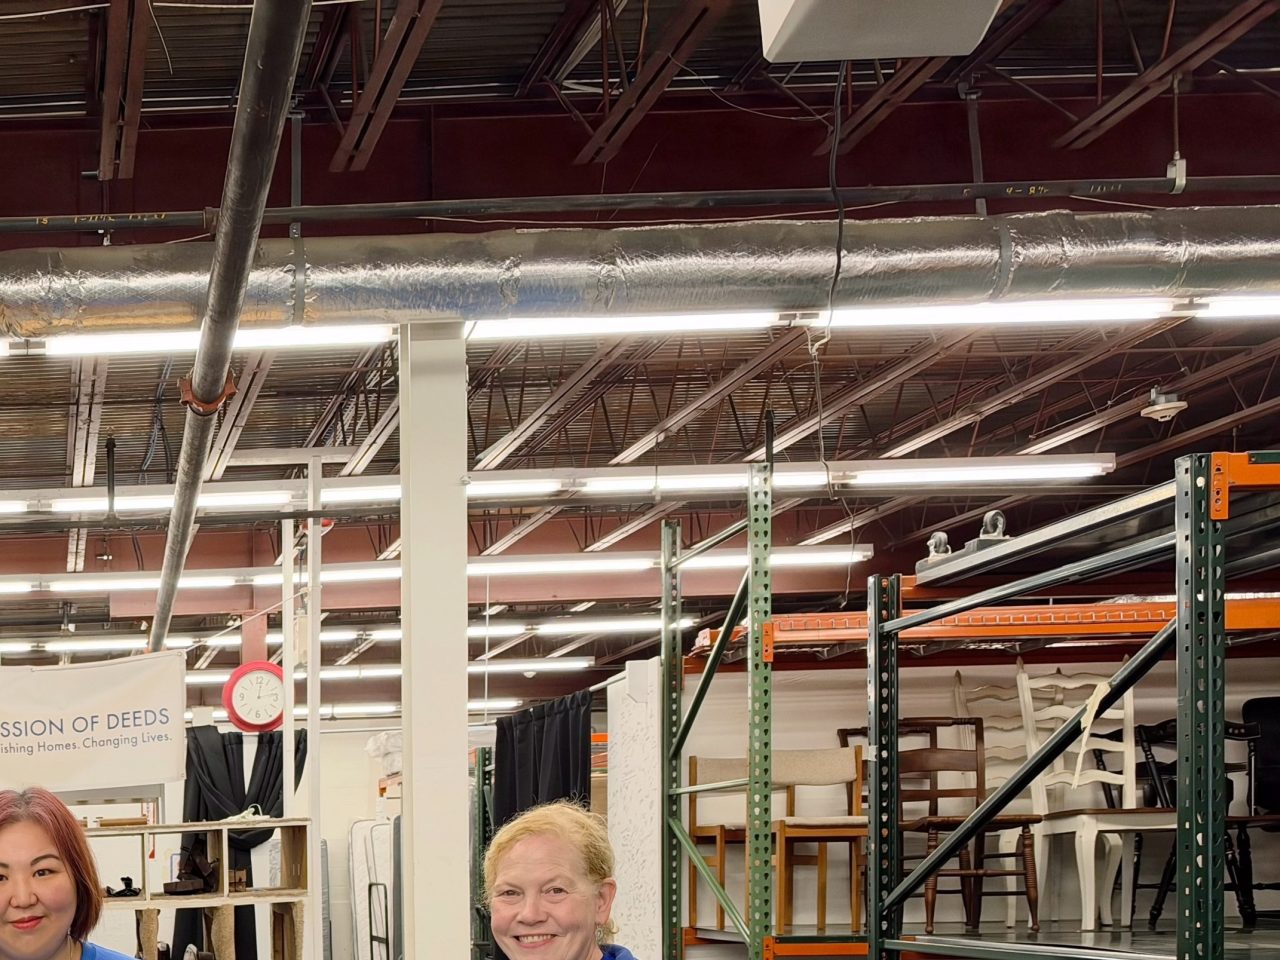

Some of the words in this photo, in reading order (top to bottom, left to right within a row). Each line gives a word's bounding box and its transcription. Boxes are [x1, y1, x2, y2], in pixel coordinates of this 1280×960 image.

[255, 676, 264, 684] 12
[72, 715, 99, 733] OF
[107, 707, 170, 730] DEEDS
[37, 741, 80, 752] Homes.
[82, 734, 138, 749] Changing
[141, 731, 173, 744] Lives.
